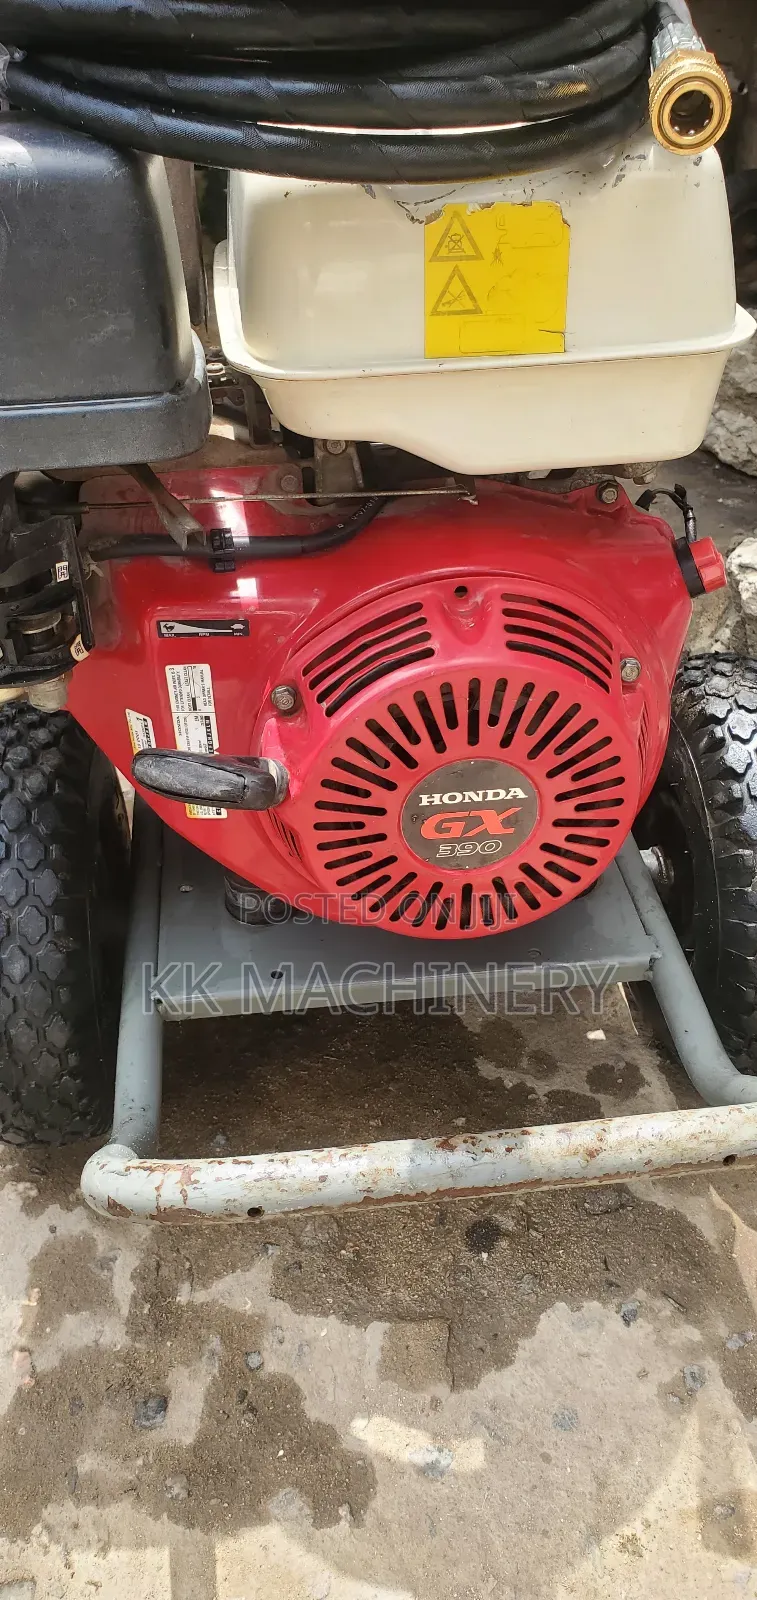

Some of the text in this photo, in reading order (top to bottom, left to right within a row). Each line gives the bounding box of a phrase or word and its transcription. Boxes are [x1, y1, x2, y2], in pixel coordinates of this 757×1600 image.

[419, 787, 528, 806] HONDA
[420, 806, 523, 840] GX
[436, 839, 502, 858] 390
